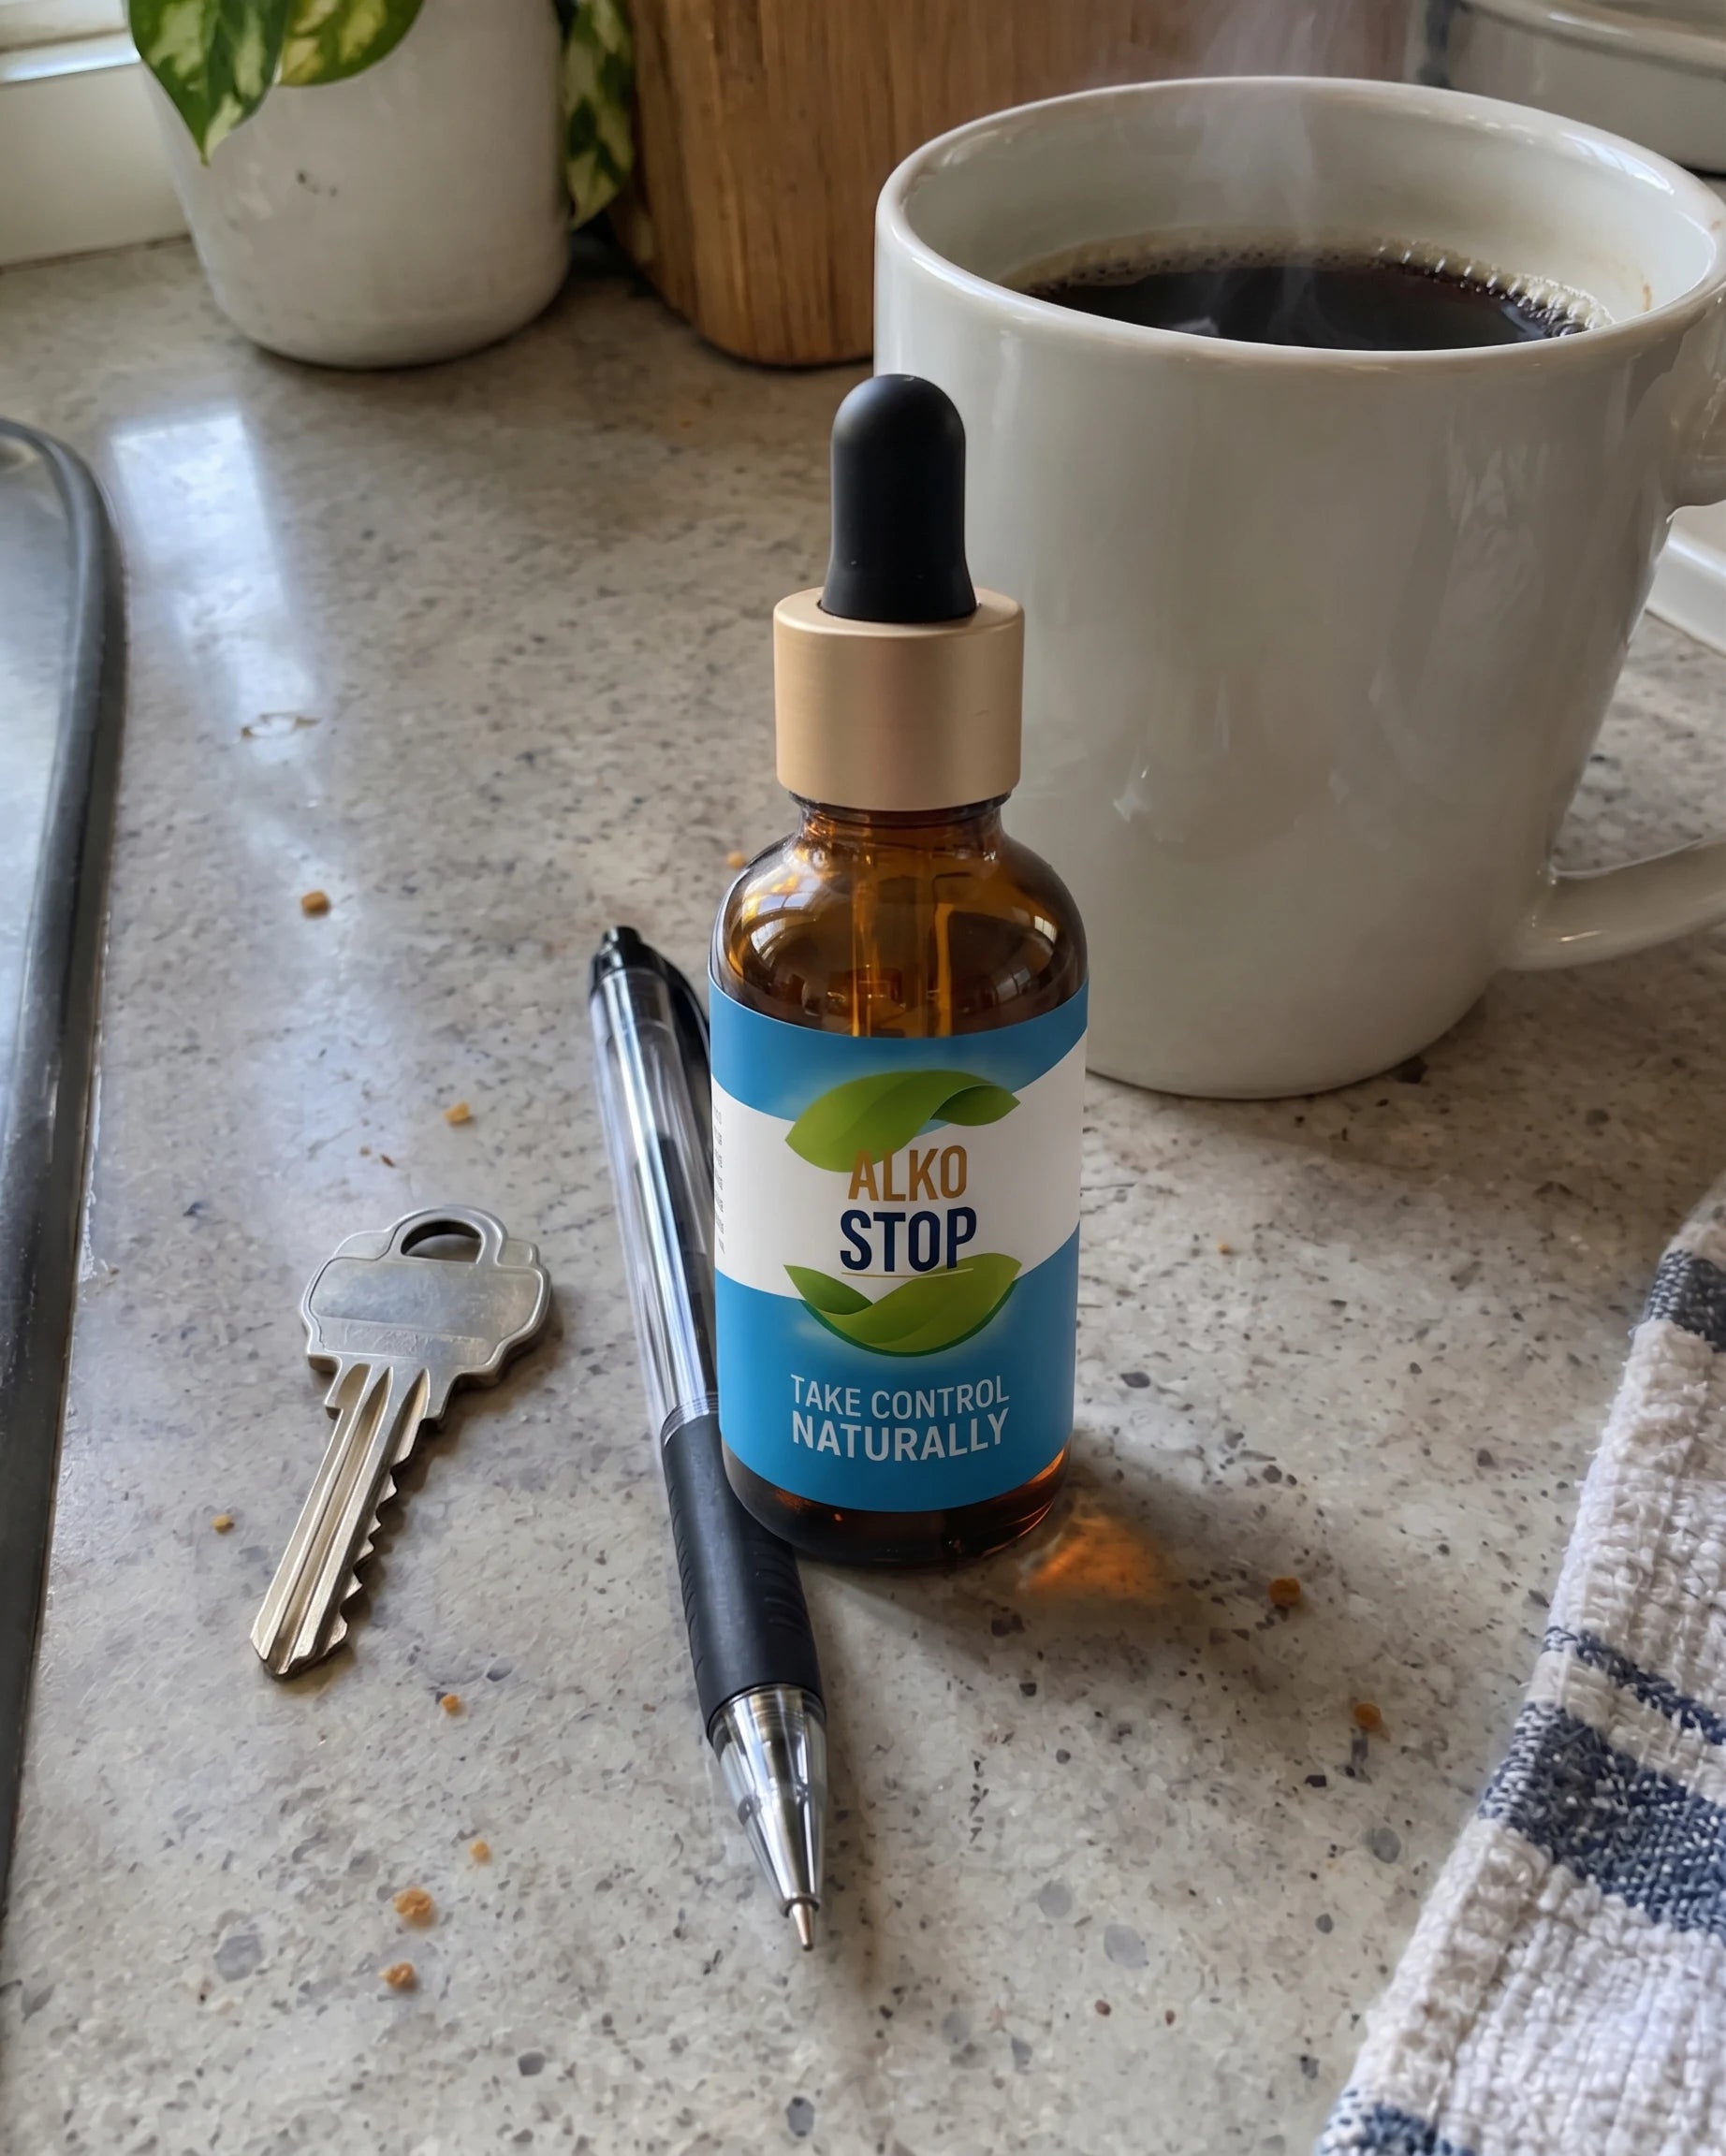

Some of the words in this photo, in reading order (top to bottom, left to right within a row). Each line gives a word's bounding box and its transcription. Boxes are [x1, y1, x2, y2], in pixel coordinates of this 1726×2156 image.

[849, 1146, 967, 1202] ALKO
[841, 1207, 977, 1273] STOP
[790, 1375, 861, 1417] TAKE
[871, 1376, 1009, 1420] CONTROL
[793, 1408, 1009, 1462] NATURALLY
